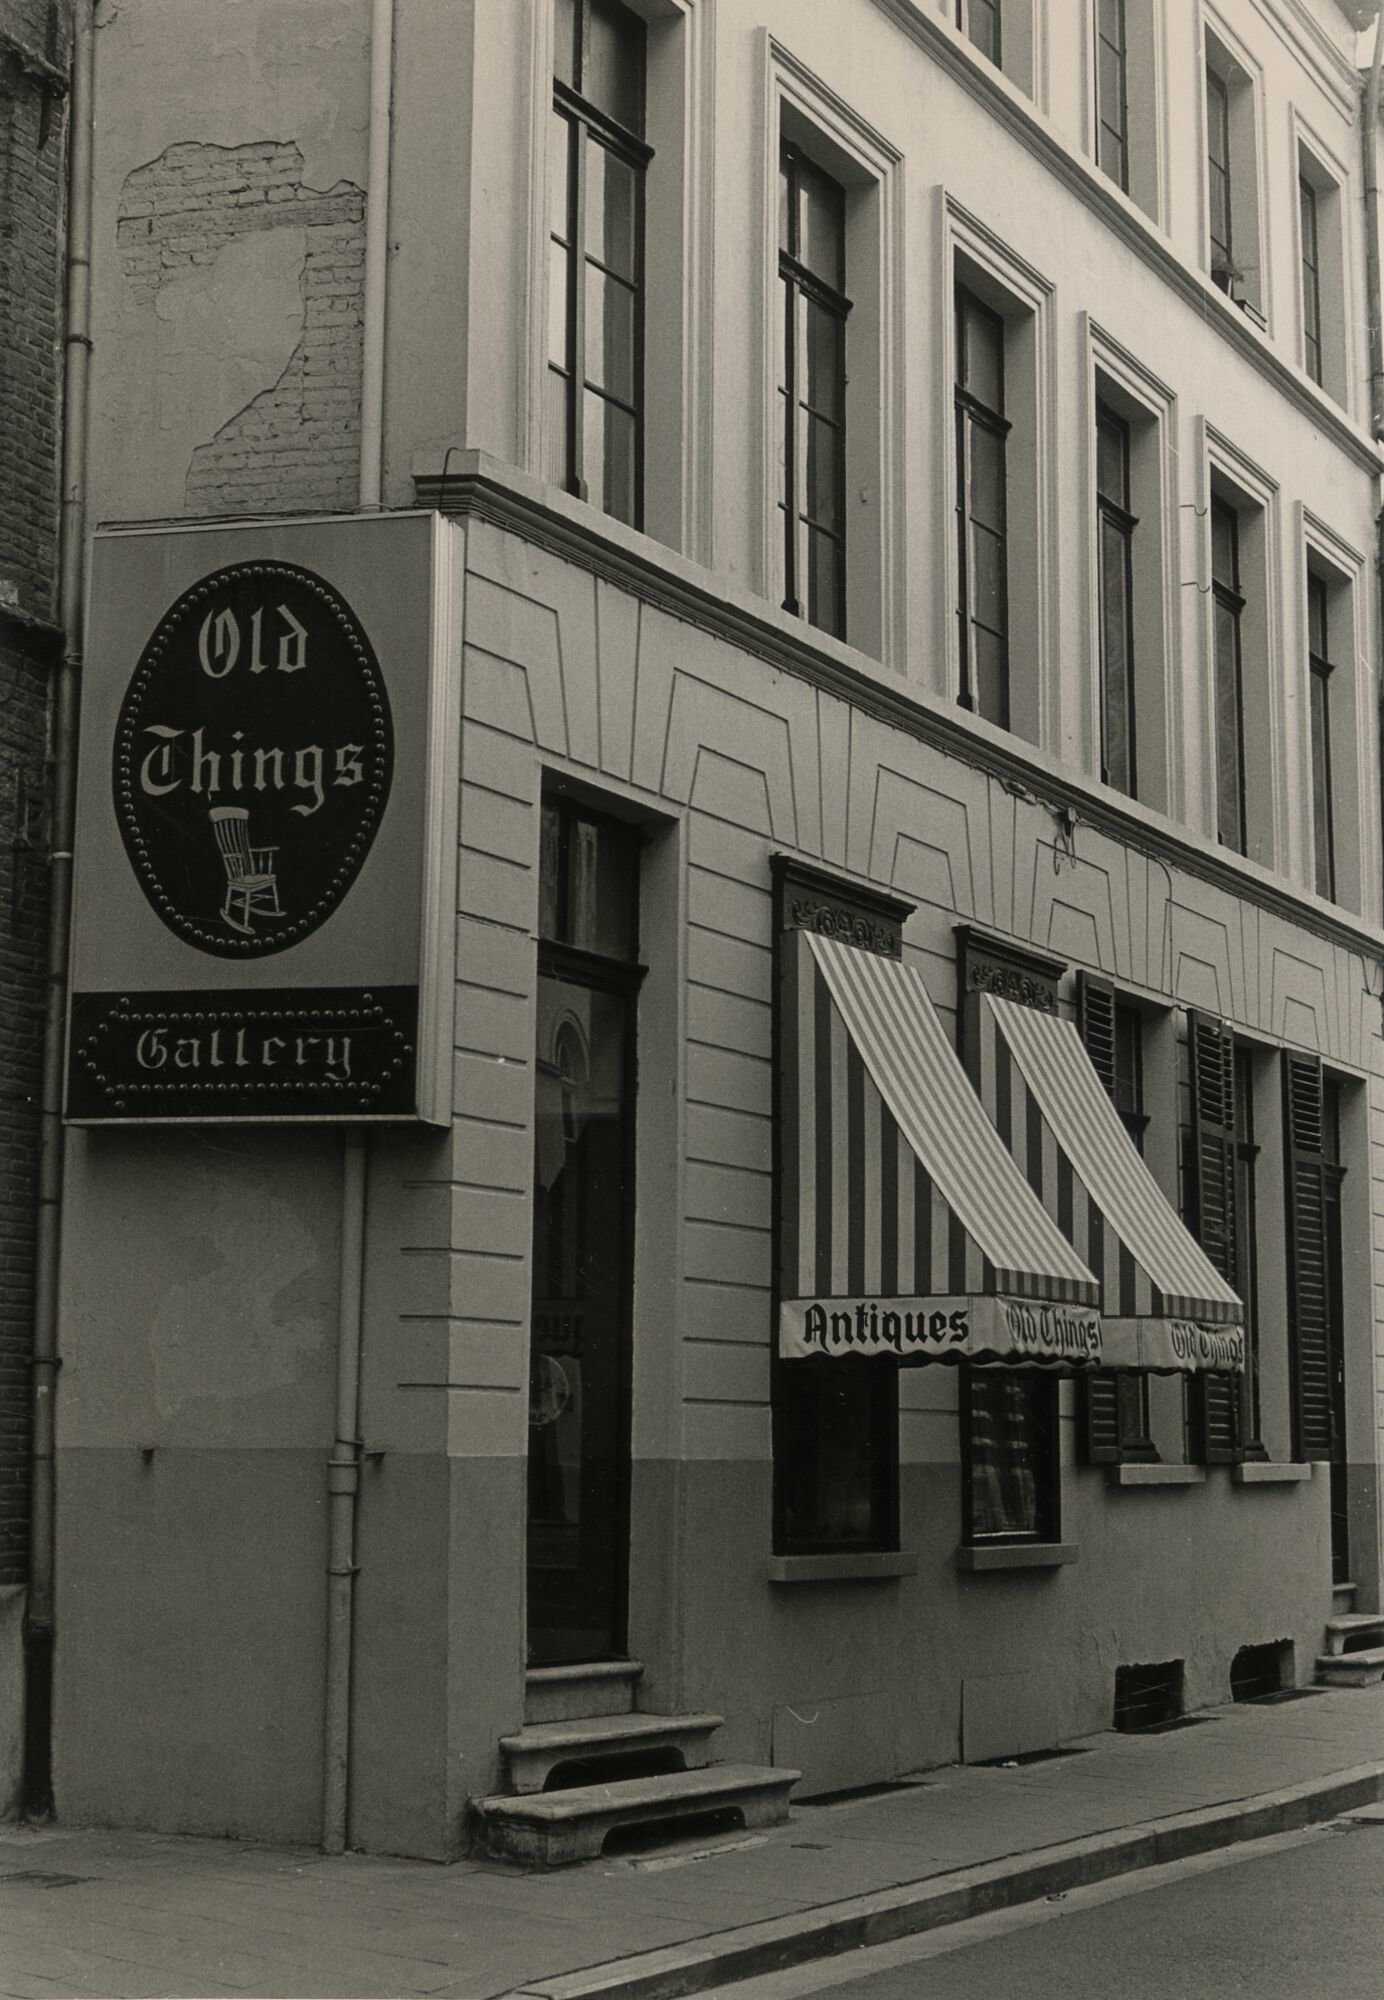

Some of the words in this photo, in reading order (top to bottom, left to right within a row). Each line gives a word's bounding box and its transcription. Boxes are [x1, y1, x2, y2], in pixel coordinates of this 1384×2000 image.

[198, 604, 309, 679] Old
[139, 724, 366, 817] Things
[135, 1027, 353, 1081] Gallery
[802, 1302, 970, 1353] Antiques
[1005, 1303, 1037, 1345] Old
[1039, 1305, 1099, 1358] Things
[1170, 1322, 1197, 1360] Old
